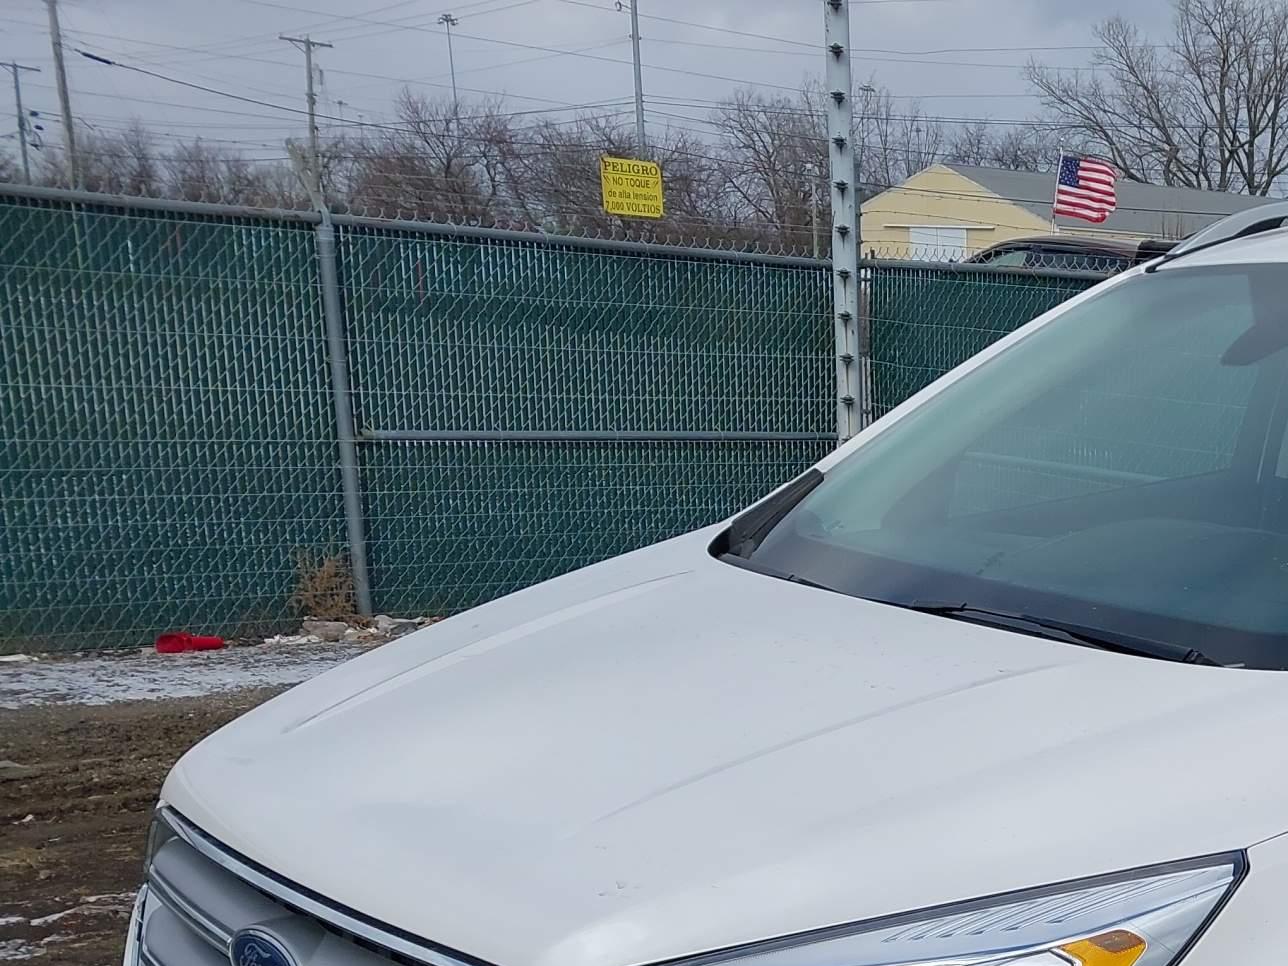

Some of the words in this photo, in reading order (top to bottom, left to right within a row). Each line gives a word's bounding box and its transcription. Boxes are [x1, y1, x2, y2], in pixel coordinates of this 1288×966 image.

[603, 161, 658, 176] PELIGRO
[612, 176, 624, 186] NO
[625, 177, 651, 189] TOQUE
[608, 189, 617, 198] de
[626, 202, 661, 214] VOLTIOS
